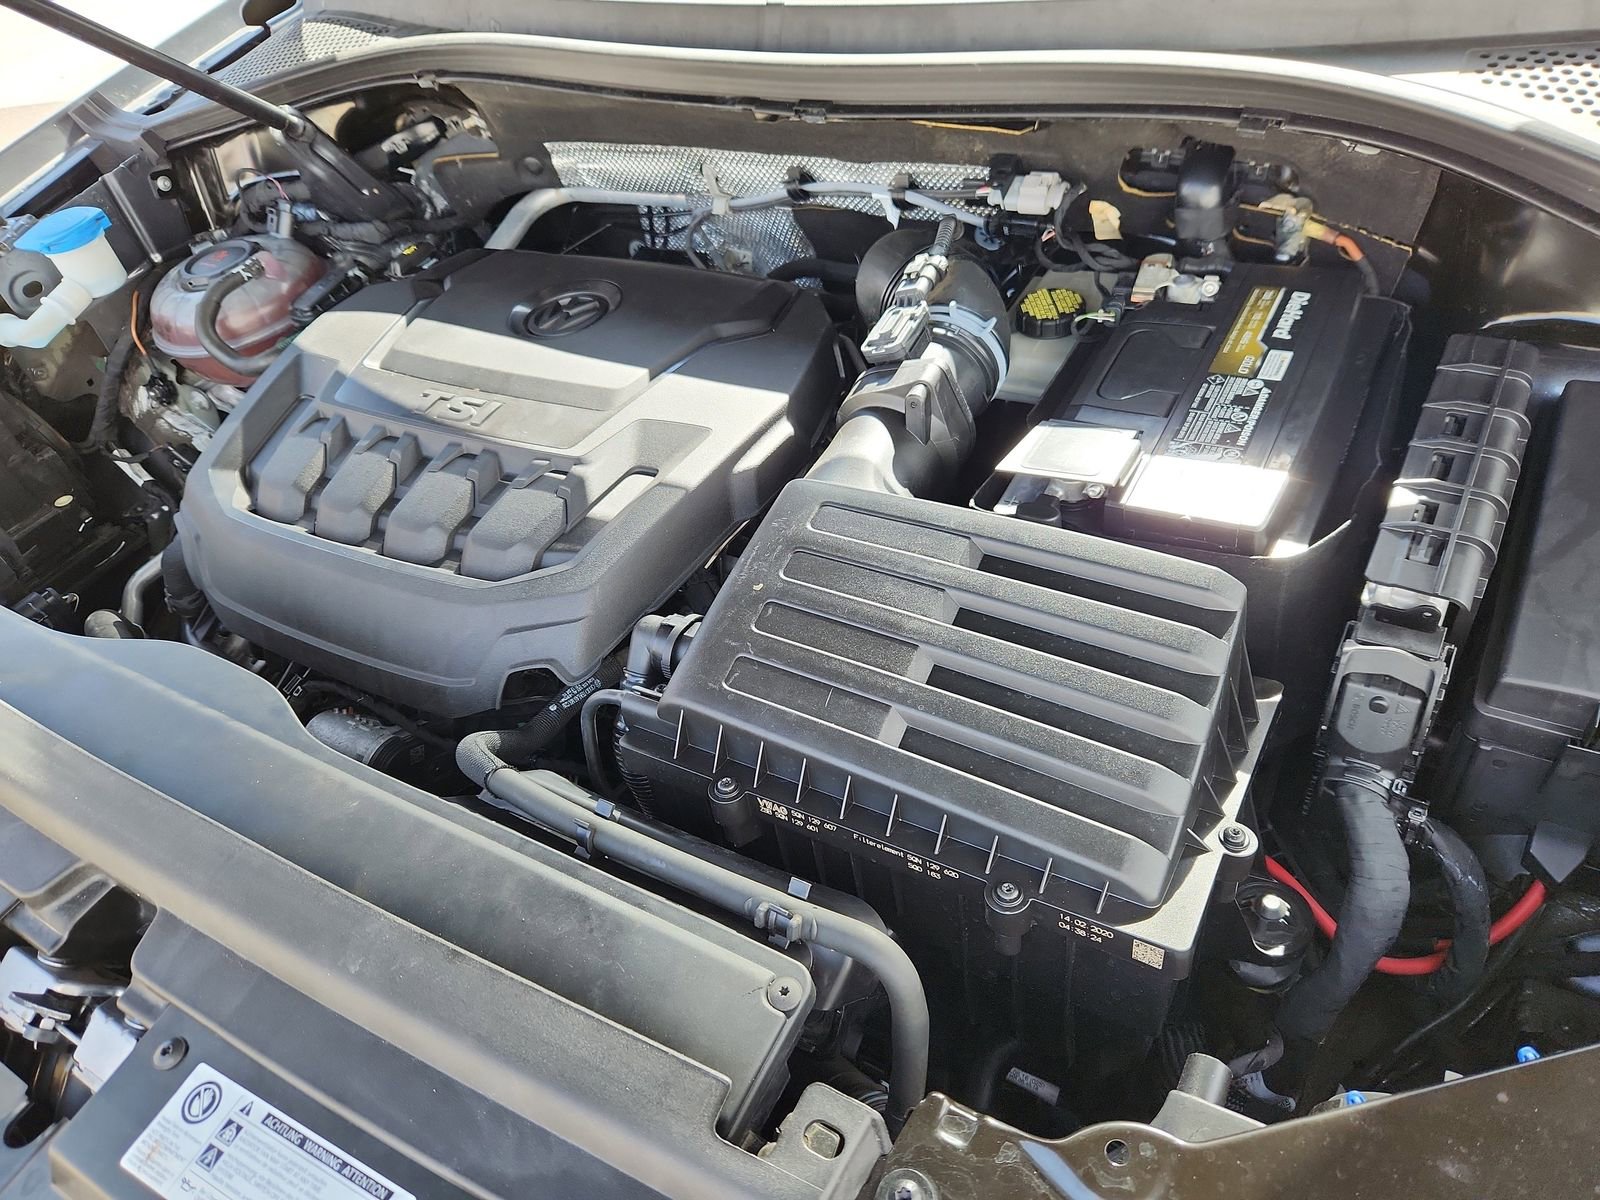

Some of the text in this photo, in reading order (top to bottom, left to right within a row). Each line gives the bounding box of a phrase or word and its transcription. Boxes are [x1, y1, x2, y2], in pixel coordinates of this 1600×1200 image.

[1272, 291, 1312, 340] DieHard
[1238, 354, 1255, 375] GOLD
[414, 389, 505, 427] TSI
[790, 818, 804, 827] 129
[806, 824, 819, 833] 601
[808, 816, 821, 826] 129
[823, 823, 838, 832] 607
[926, 861, 940, 871] 129
[264, 1115, 303, 1146] ACHTUNG
[304, 1138, 343, 1170] WARNING
[341, 1162, 390, 1200] ATTENTION
